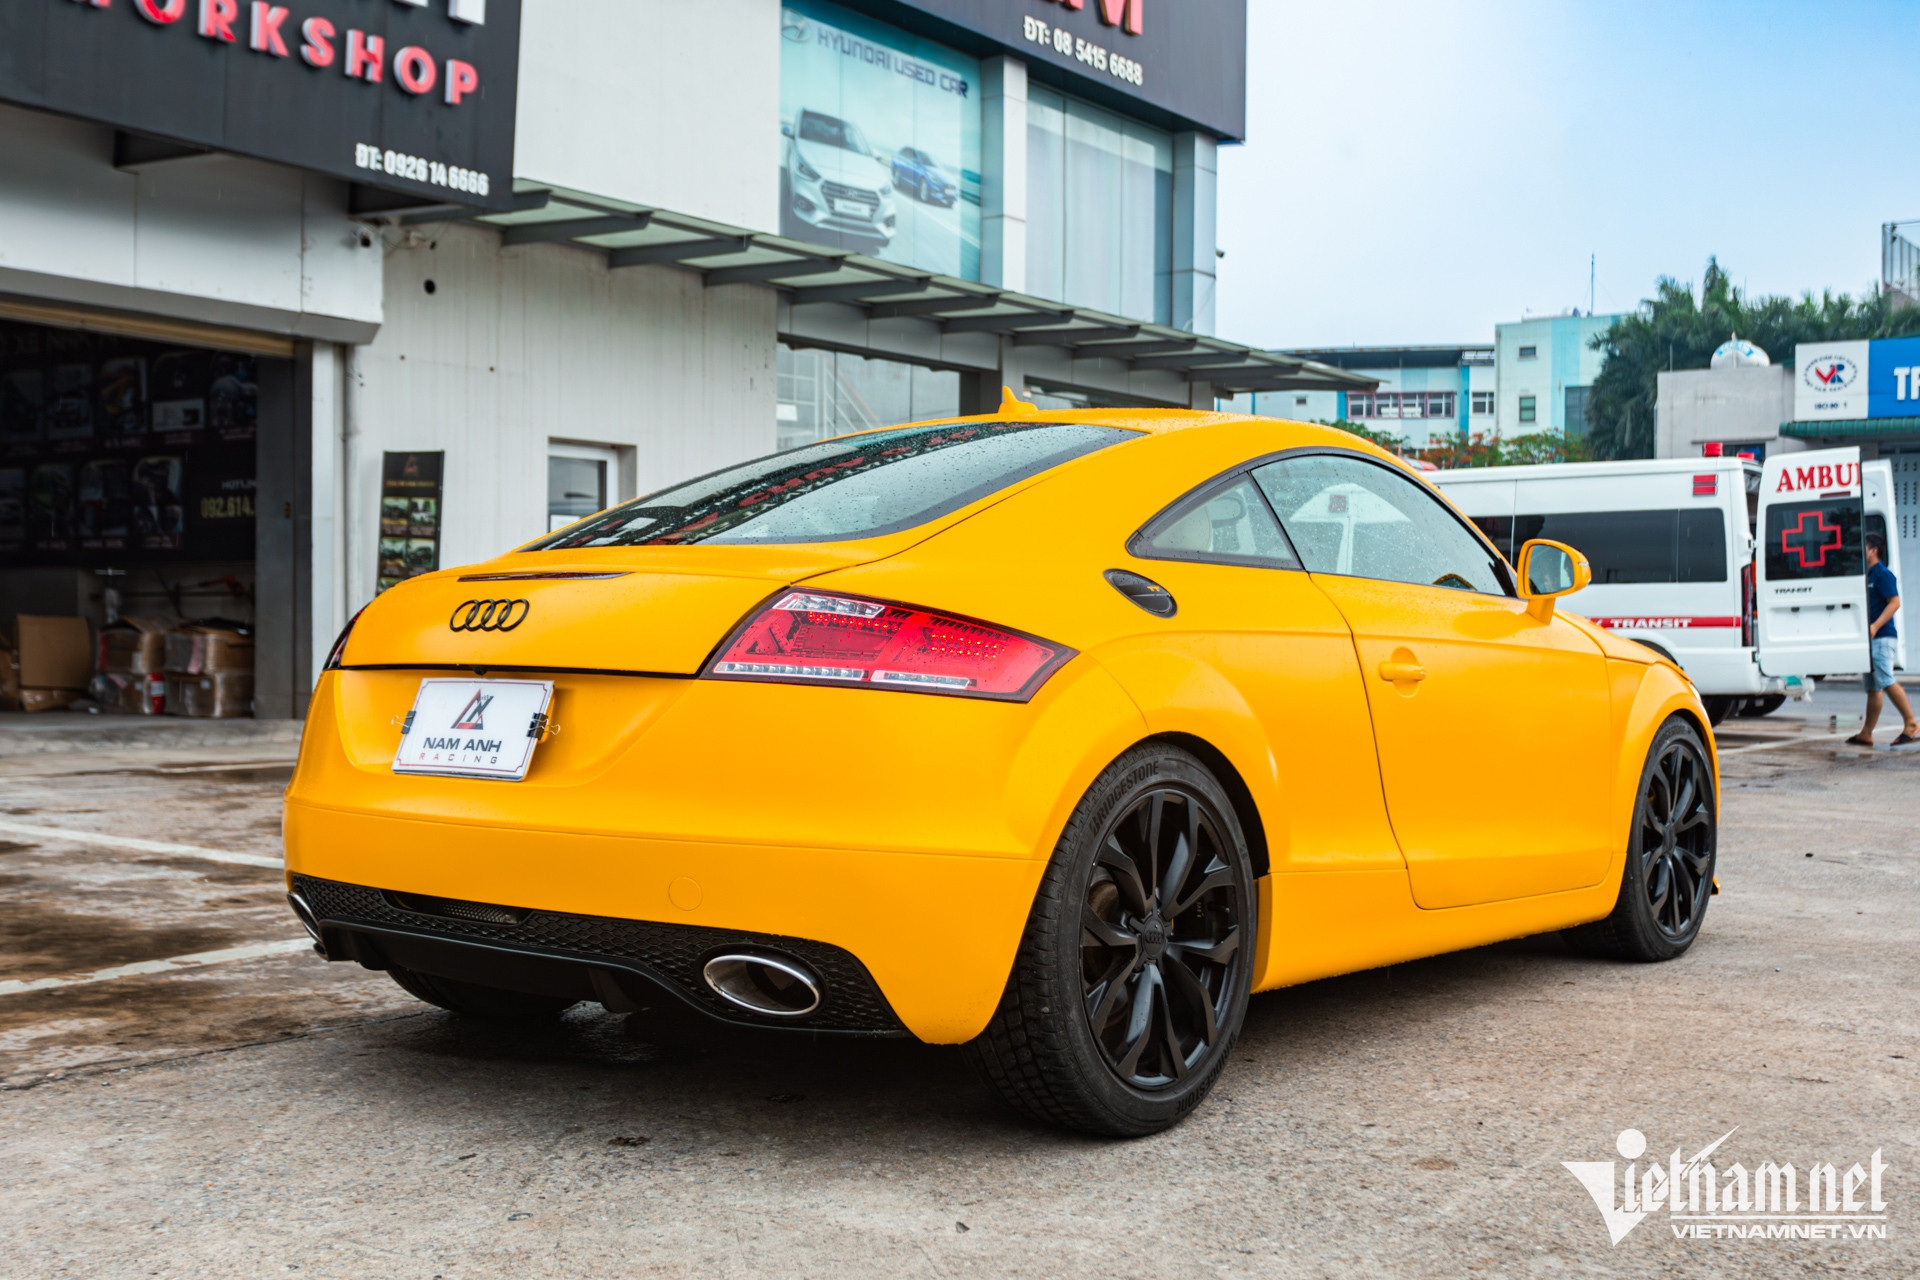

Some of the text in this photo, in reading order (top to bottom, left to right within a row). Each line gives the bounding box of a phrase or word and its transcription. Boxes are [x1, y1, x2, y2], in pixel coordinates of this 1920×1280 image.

[75, 0, 479, 105] RKSHOP
[817, 27, 969, 99] HYUNDAI USED CAR
[1024, 15, 1051, 45] ĐT:
[1053, 28, 1073, 56] 08
[1075, 37, 1108, 71] 5415
[1109, 53, 1143, 87] 6688
[384, 149, 428, 182] 0926
[1610, 618, 1692, 628] TRANSIT
[419, 752, 498, 764] RACING
[423, 737, 502, 753] NAM ANH
[1089, 760, 1160, 838] BRIDGESTONE
